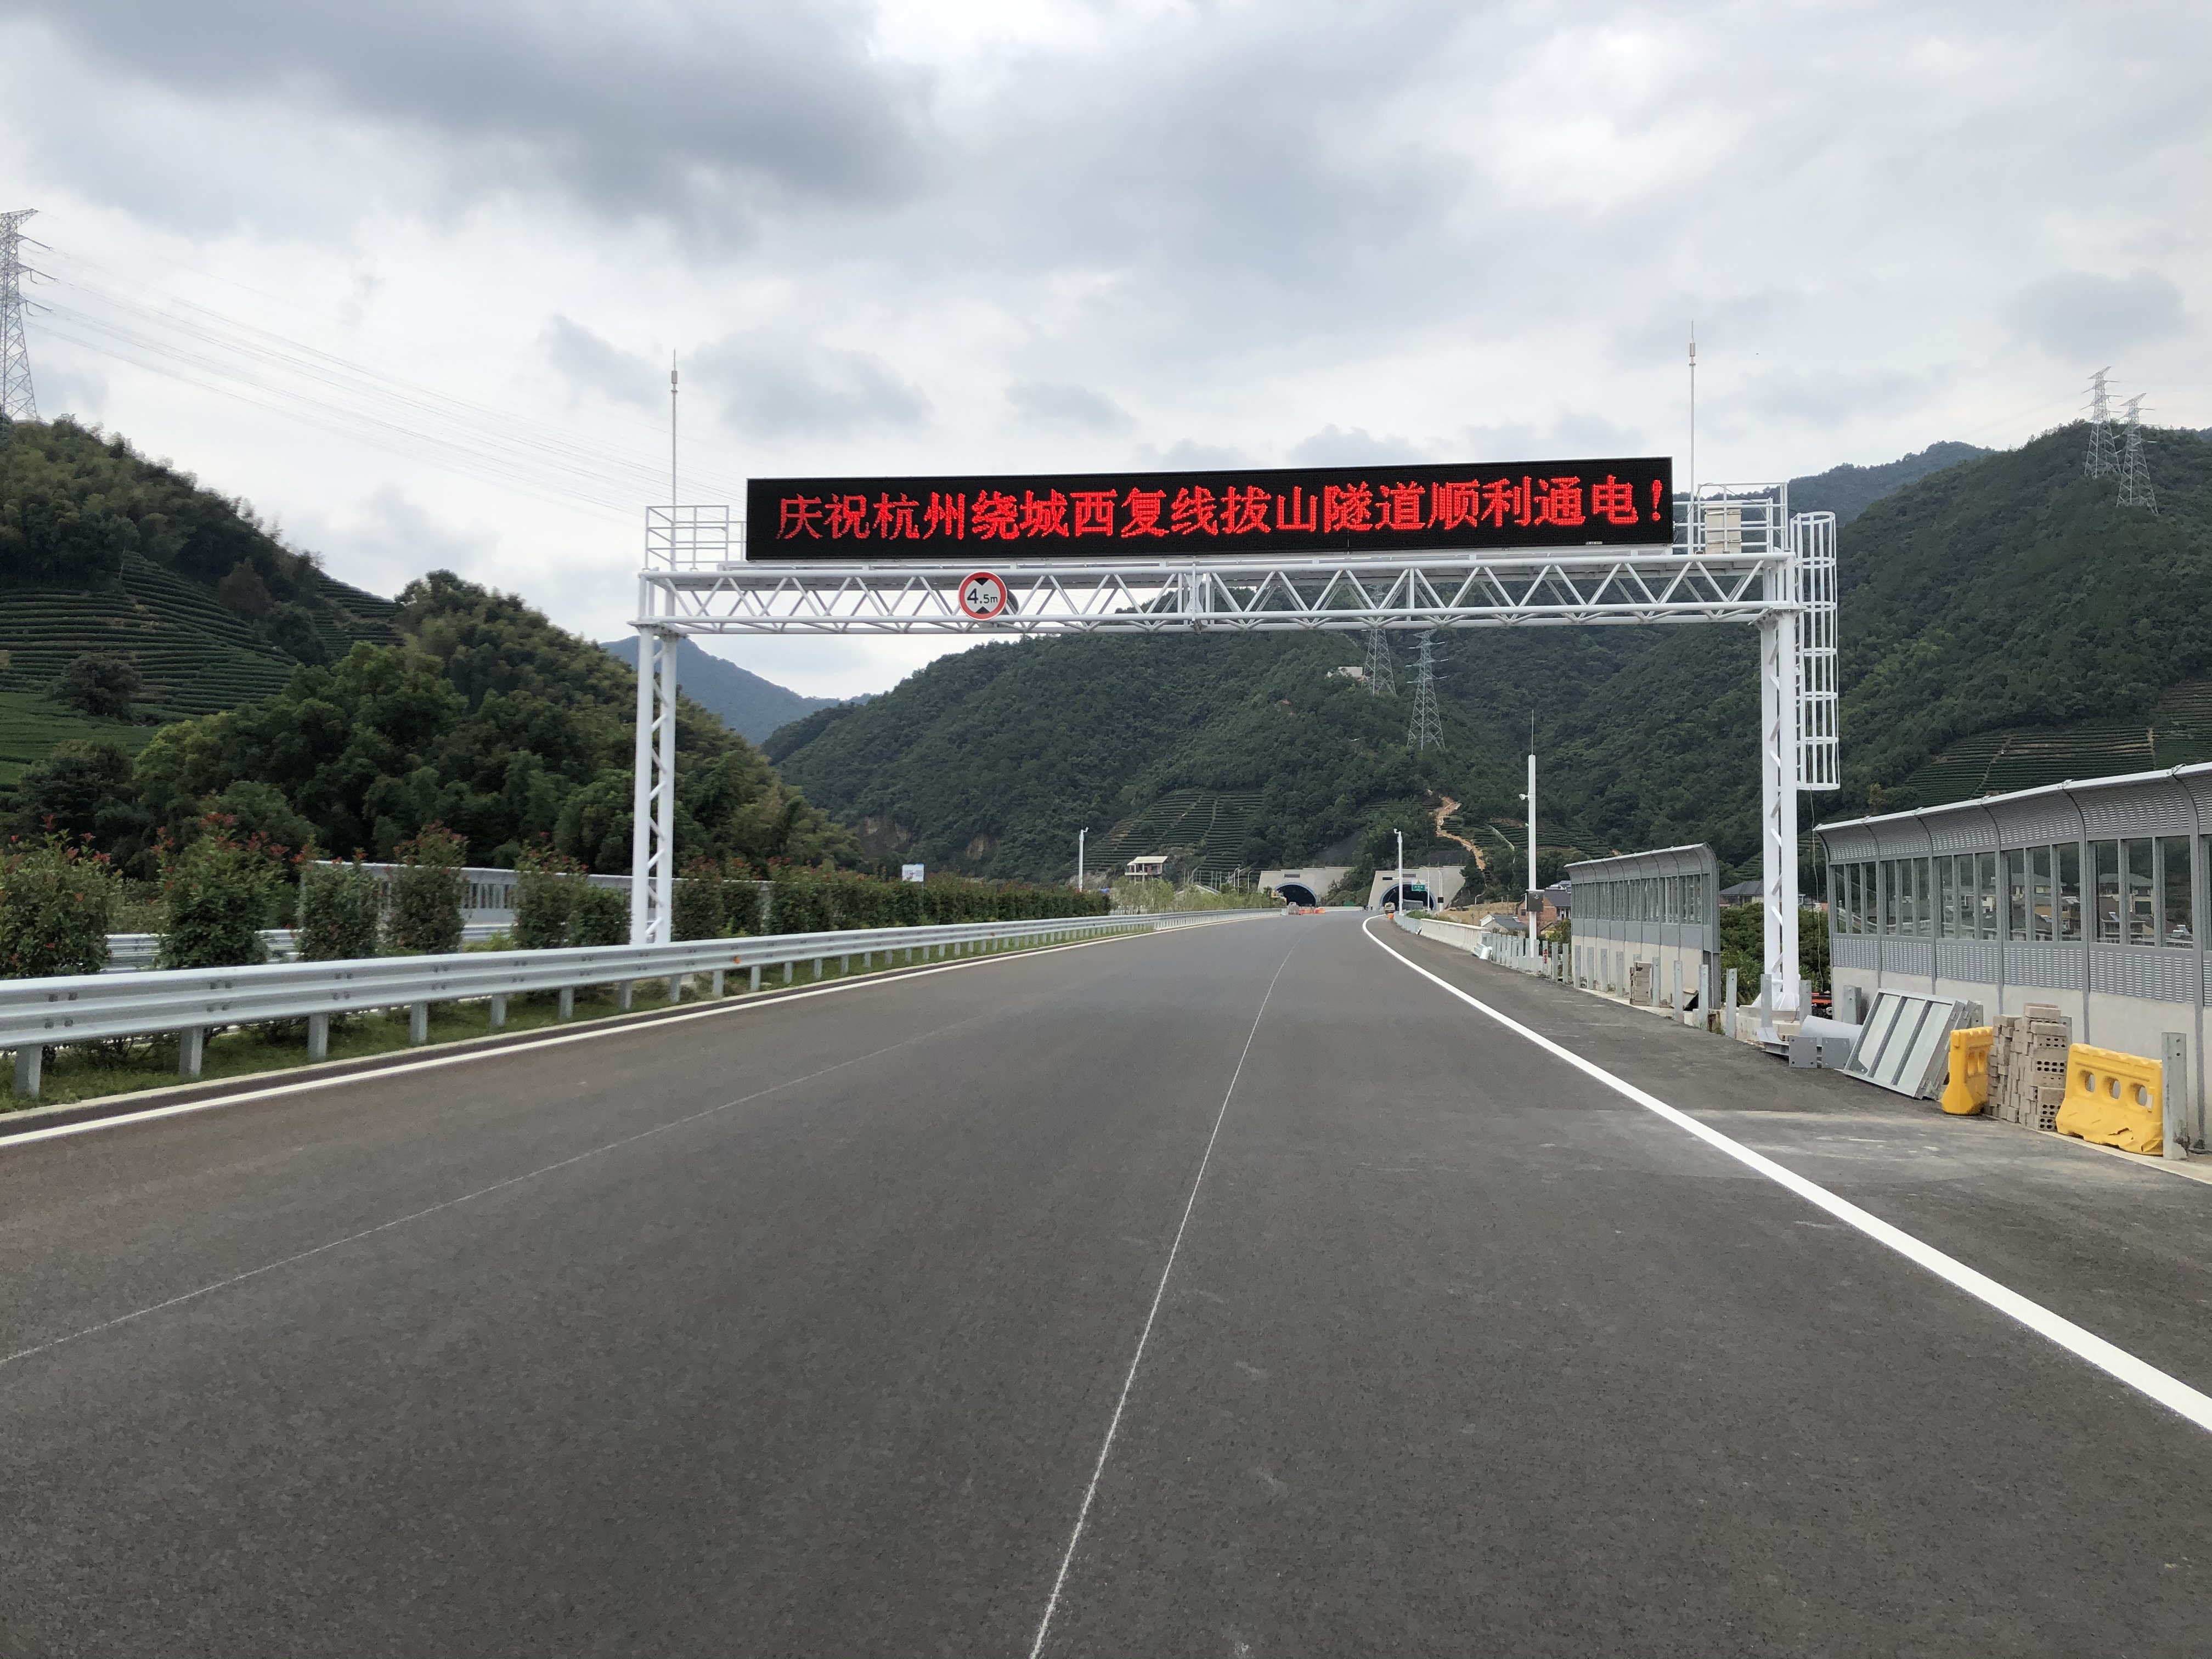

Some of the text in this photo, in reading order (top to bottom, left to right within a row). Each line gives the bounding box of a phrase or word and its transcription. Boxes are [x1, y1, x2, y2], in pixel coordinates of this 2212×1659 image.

[776, 475, 1663, 540] 庆祝杭州绕城西复线拔山隧道顺利通电!
[967, 588, 998, 604] 4.5m
